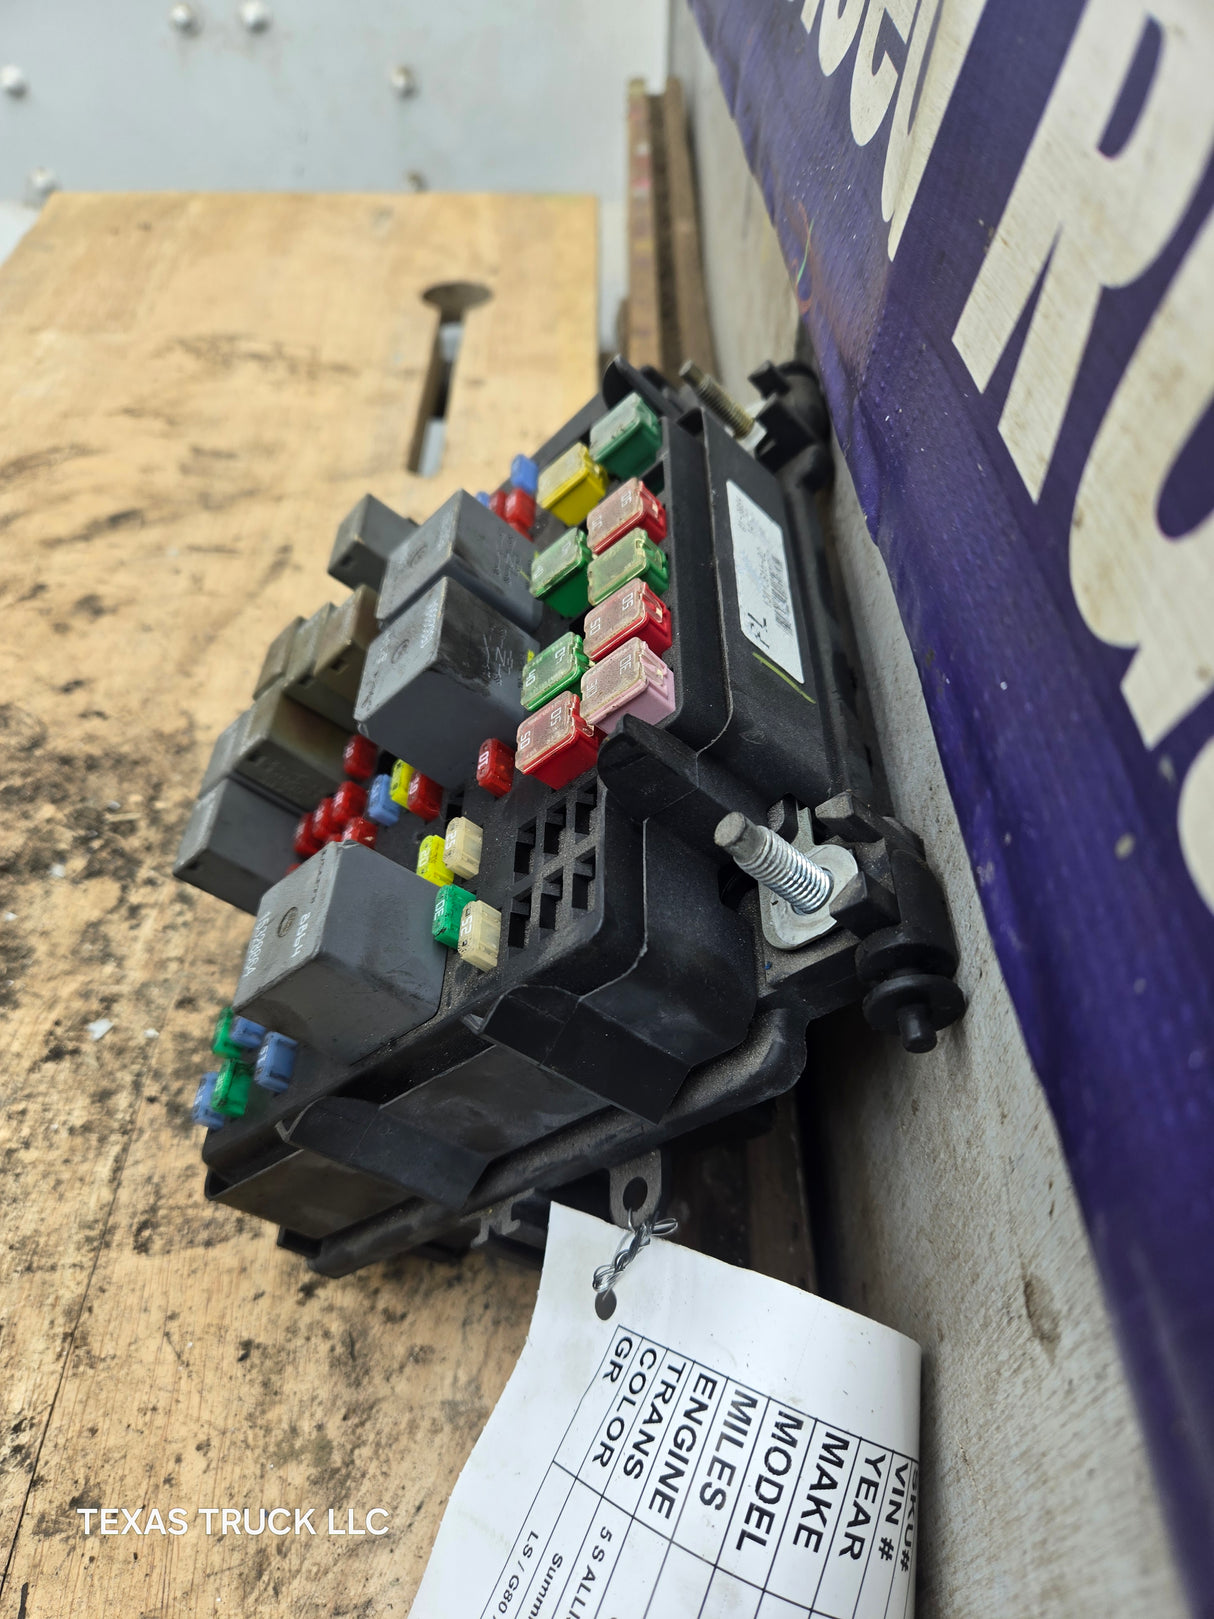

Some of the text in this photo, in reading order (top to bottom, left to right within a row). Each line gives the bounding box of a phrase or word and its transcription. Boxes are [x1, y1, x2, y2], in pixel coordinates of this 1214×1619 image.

[526, 668, 537, 688] 40
[477, 750, 490, 770] 10
[520, 730, 531, 750] 50
[433, 899, 446, 921] 30
[460, 914, 473, 937] 25
[602, 1335, 633, 1384] GR
[591, 1347, 658, 1468] COLOR
[623, 1361, 687, 1480] TRANS
[648, 1372, 718, 1519] ENGINE
[699, 1389, 758, 1512] MILES
[736, 1409, 804, 1551] MODEL
[792, 1431, 851, 1553] MAKE
[838, 1453, 886, 1560] YEAR
[878, 1462, 909, 1561] VIN #
[522, 1530, 539, 1558] LS
[566, 1525, 613, 1619] 5 S ALLI
[498, 1574, 520, 1614] G80
[528, 1553, 563, 1619] Summ
